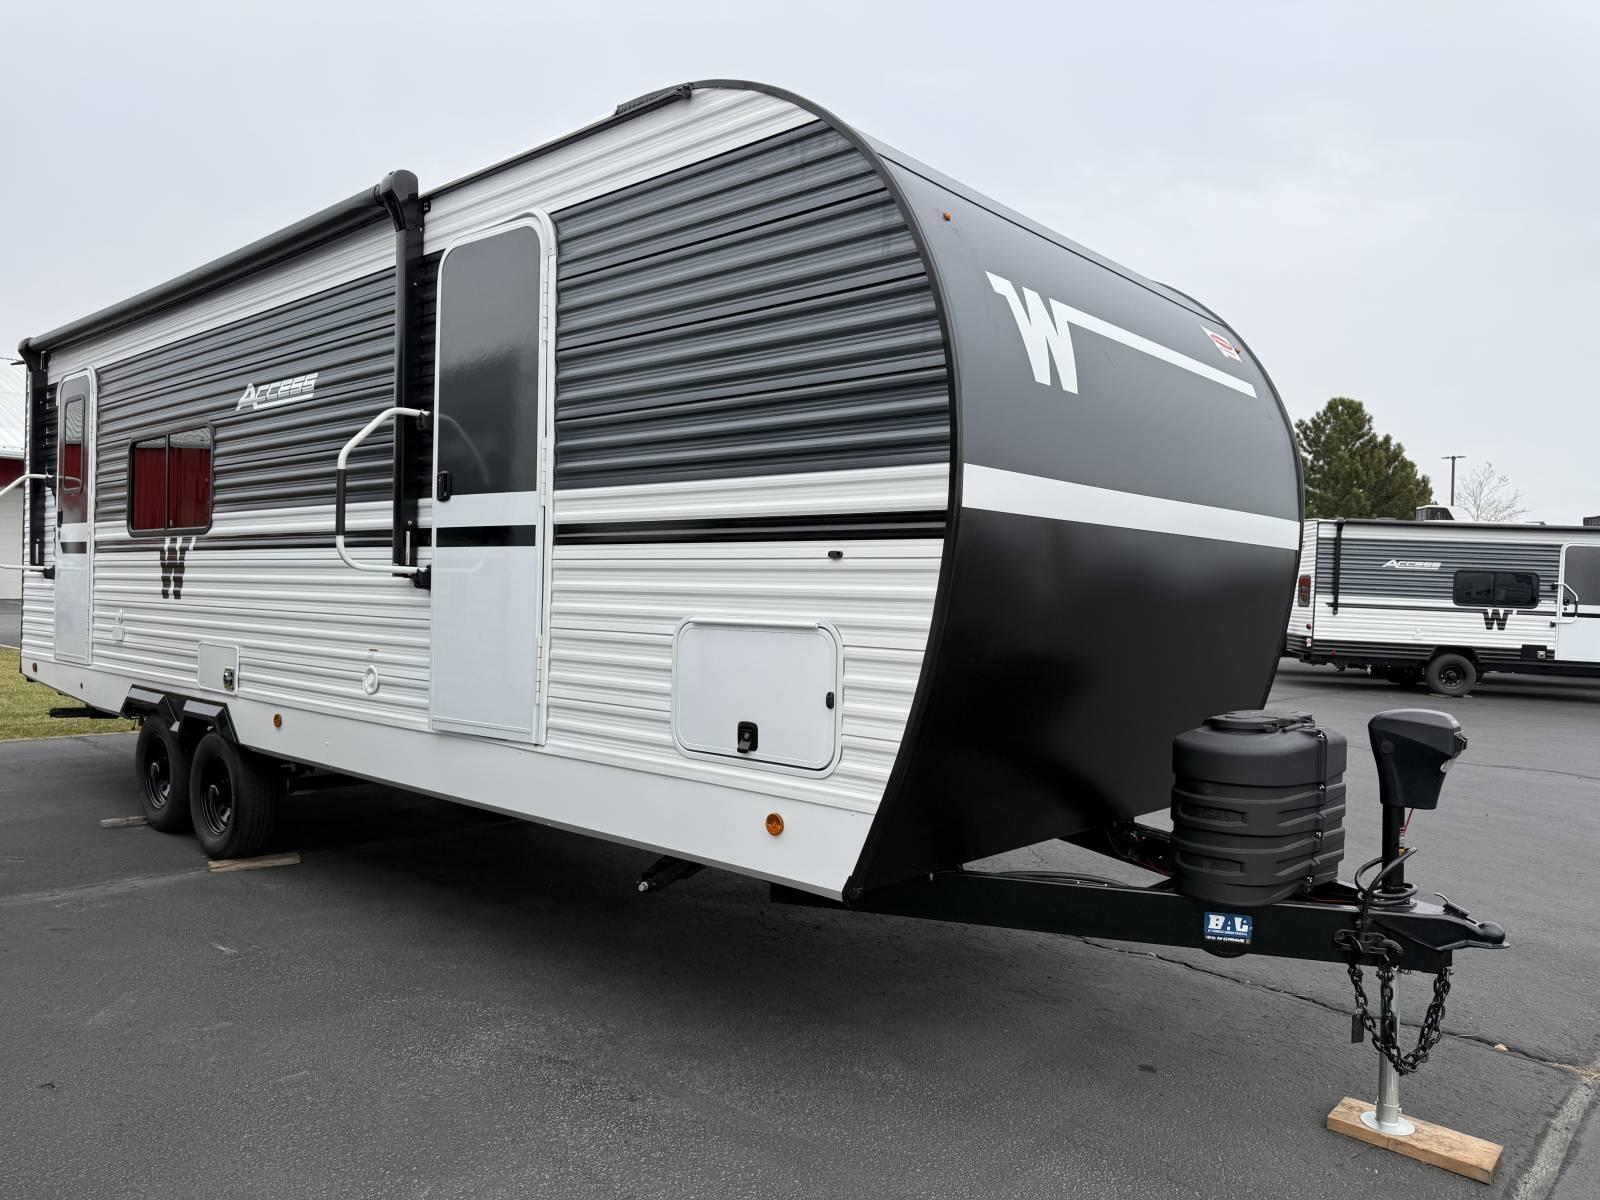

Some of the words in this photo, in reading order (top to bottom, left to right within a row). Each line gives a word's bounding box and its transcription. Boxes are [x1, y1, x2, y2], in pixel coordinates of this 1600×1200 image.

[985, 271, 1078, 395] W
[235, 372, 319, 411] ACCESS
[1382, 559, 1442, 570] ACCESS
[1482, 608, 1513, 631] W
